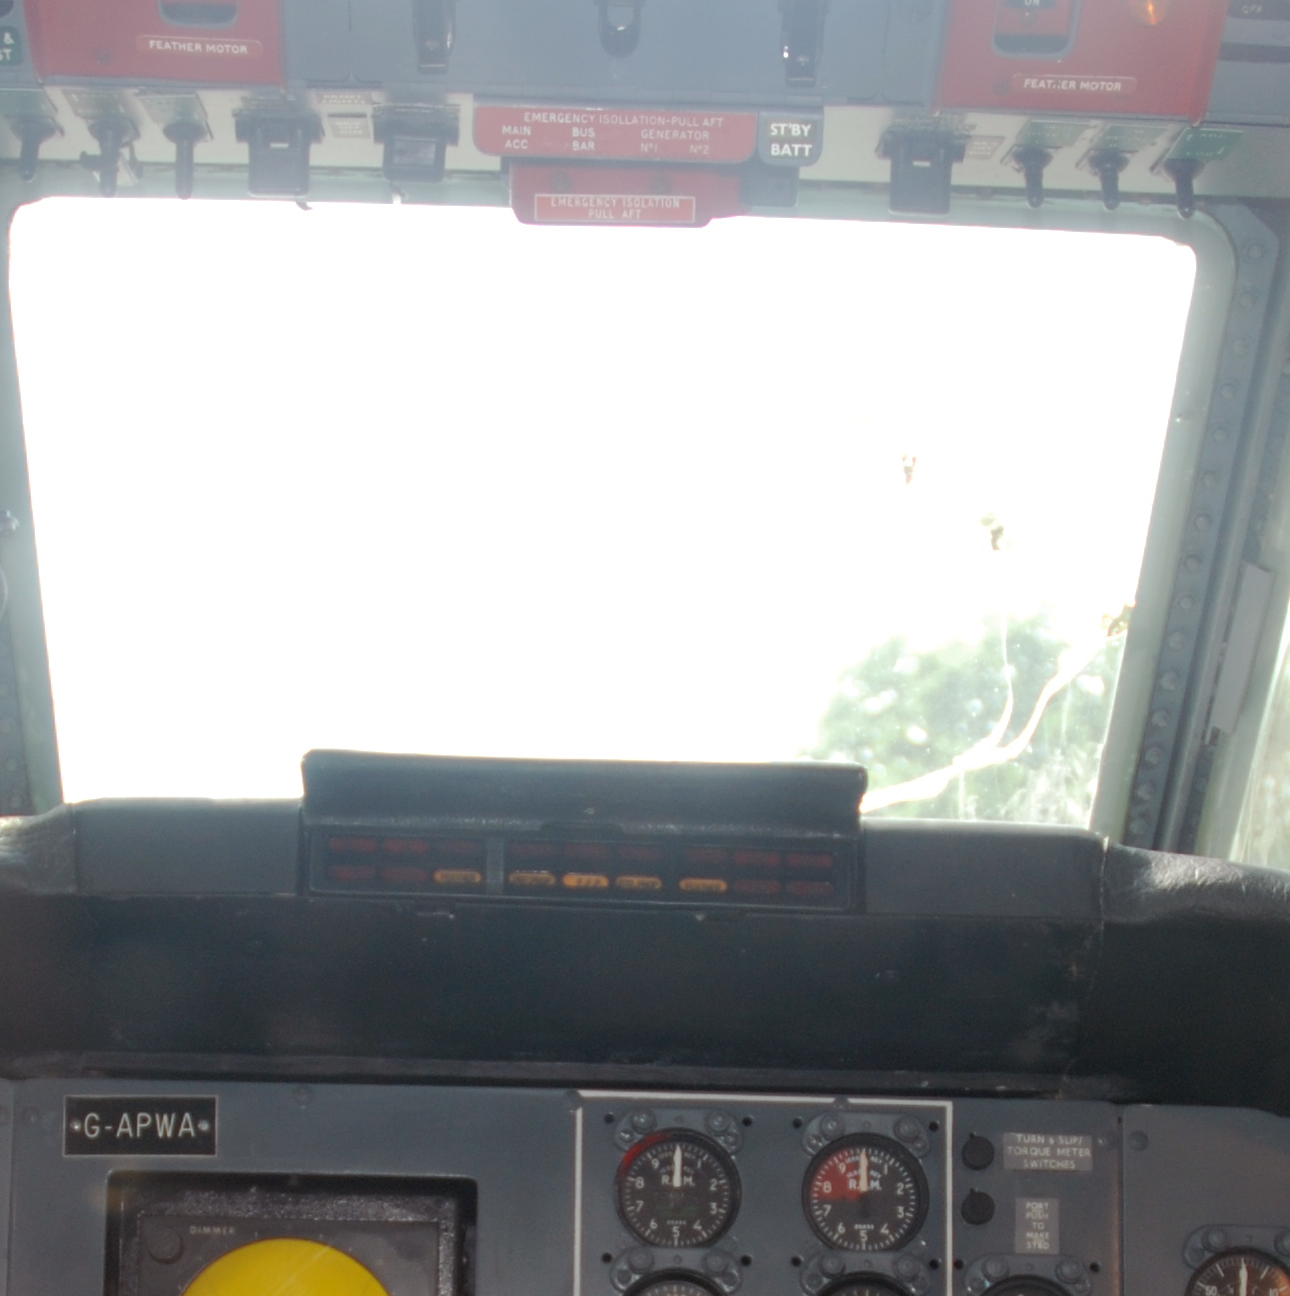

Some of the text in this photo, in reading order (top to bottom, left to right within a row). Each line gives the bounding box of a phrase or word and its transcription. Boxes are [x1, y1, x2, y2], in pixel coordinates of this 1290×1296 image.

[4, 32, 15, 45] &
[149, 40, 248, 54] FEATHER MOTOR
[1080, 80, 1122, 91] MOTOR
[524, 112, 723, 127] EMERGENCY ISOLLATION-PULL AFT
[502, 125, 531, 135] MAIN
[572, 127, 596, 138] BUS
[641, 129, 710, 140] GENERATOR
[770, 123, 812, 137] ST'BY
[505, 139, 528, 149] ACC
[572, 141, 596, 151] BAR
[771, 143, 812, 157] BATT
[551, 197, 680, 208] EMERGENCY ISOLATION
[588, 209, 642, 219] PULL AFT
[84, 1112, 195, 1138] G-APWA
[1017, 1134, 1044, 1144] TURN
[1007, 1146, 1091, 1157] TORQUE METER
[1023, 1160, 1075, 1168] SWITCHES
[189, 1226, 236, 1235] DIMMER
